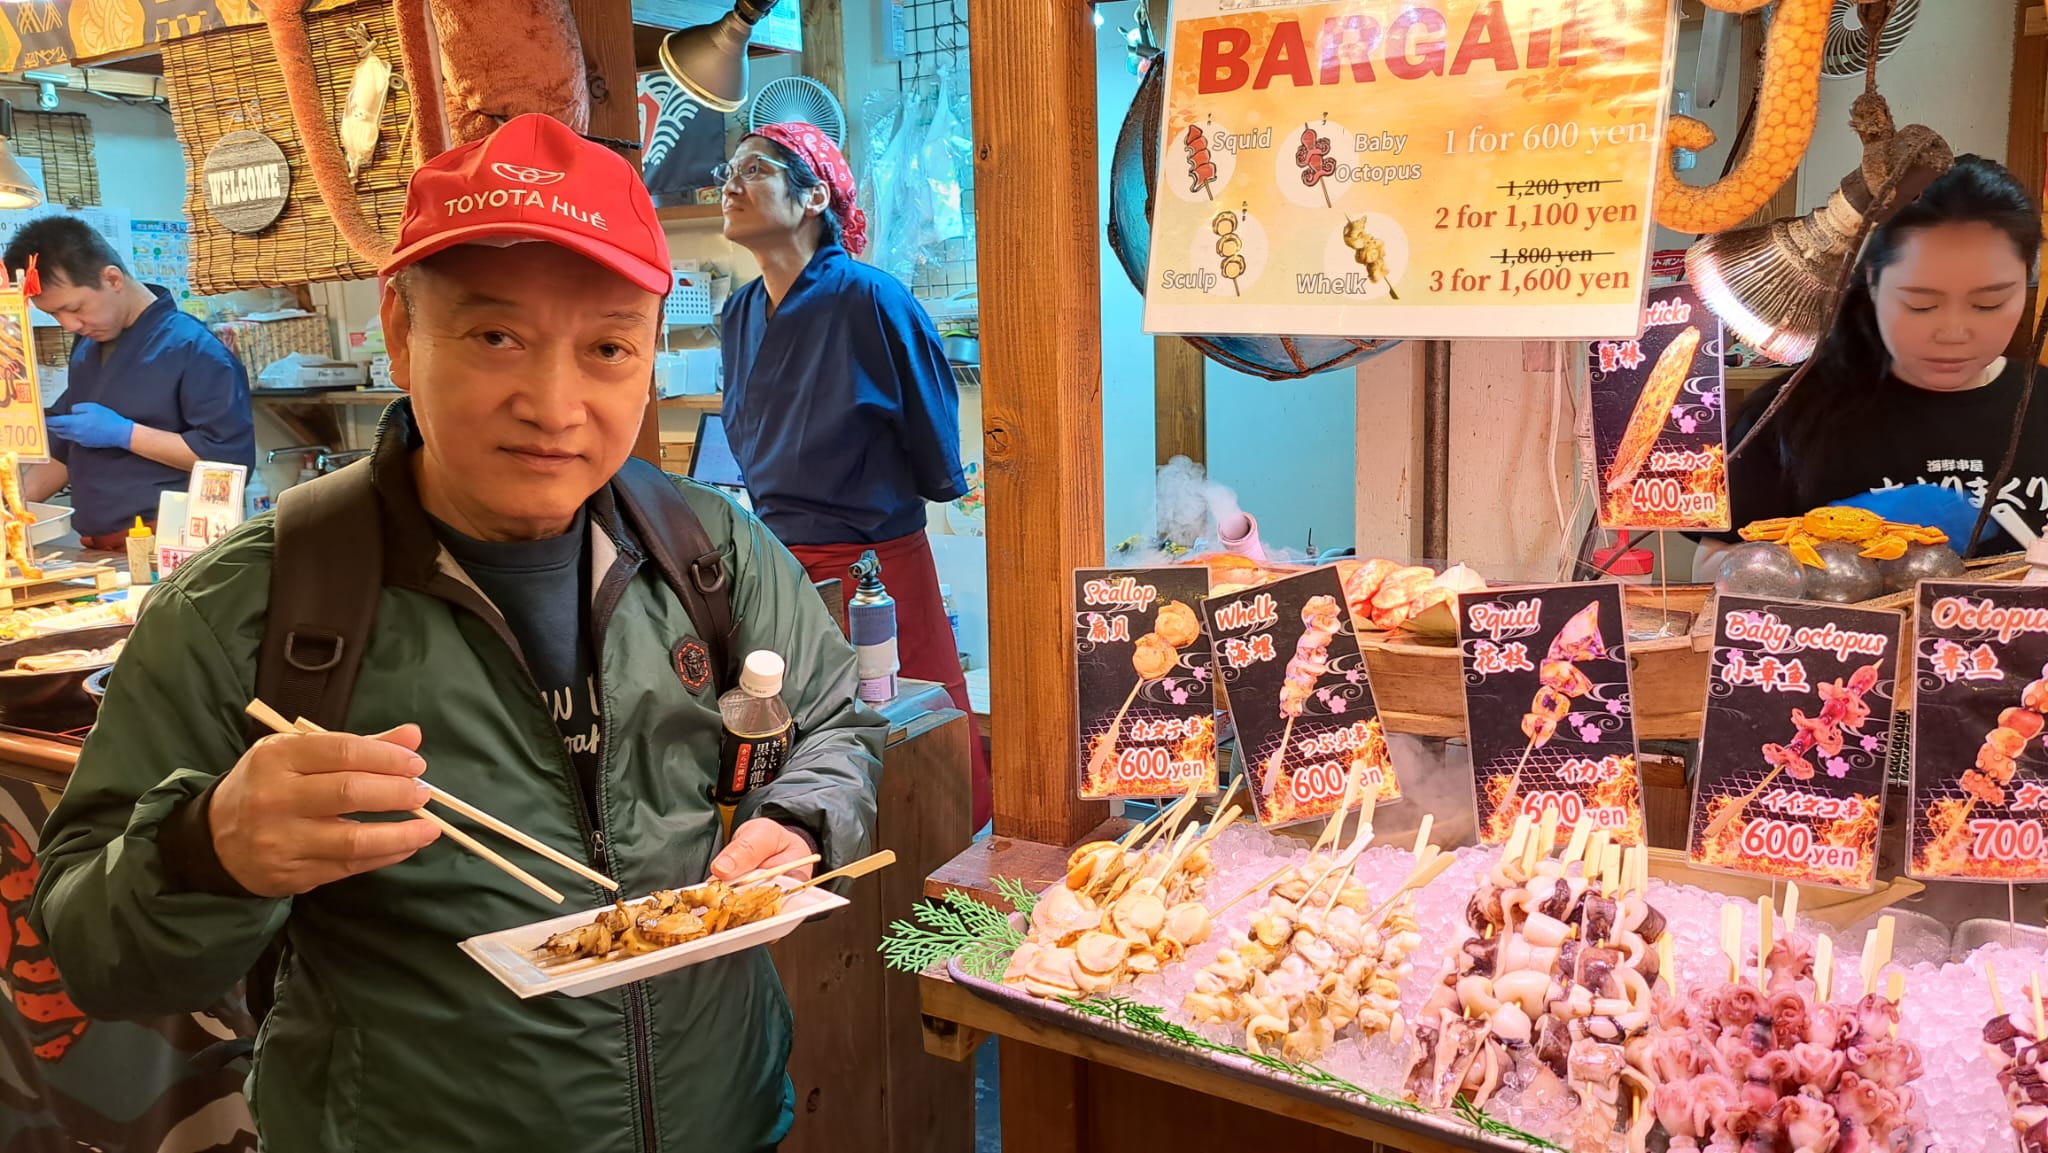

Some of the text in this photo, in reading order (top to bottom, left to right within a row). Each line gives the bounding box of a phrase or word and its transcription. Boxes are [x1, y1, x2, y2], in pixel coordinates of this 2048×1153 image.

[1198, 0, 1626, 95] BARGAIN
[1212, 127, 1272, 155] Squid
[1354, 131, 1408, 156] Baby
[1443, 121, 1648, 154] 1 for 600 yen
[207, 163, 281, 205] WELCOME
[1334, 161, 1422, 186] Octopus
[1506, 178, 1601, 200] 1,200 yen
[444, 188, 609, 232] TOYOTA HUÉ
[1434, 202, 1638, 233] 2 for 1,100 yen
[1499, 247, 1593, 268] 1,800 yen
[1162, 268, 1218, 294] Sculp
[1296, 271, 1368, 296] Whelk
[1428, 267, 1630, 298] 3 for 1,600 yen
[1598, 339, 1646, 372] 蟹棒
[1650, 451, 1714, 472] カニカマ
[1926, 458, 1984, 472] 海鮮串屋
[1083, 577, 1156, 612] Scallop
[1215, 593, 1278, 632] Whelk
[1468, 598, 1541, 641] Squid
[1932, 597, 2048, 643] Octopu
[1226, 633, 1277, 668] 海螺
[1725, 611, 1888, 662] Baby octopus
[1474, 643, 1535, 675] 花枝
[1722, 656, 1811, 692] 小章鱼
[1930, 643, 2004, 681] 章鱼
[1131, 716, 1205, 740] ホタテ串
[1299, 723, 1370, 758] つぶ貝串
[1557, 757, 1621, 784] イカ串
[1762, 789, 1864, 820] イイタコ串
